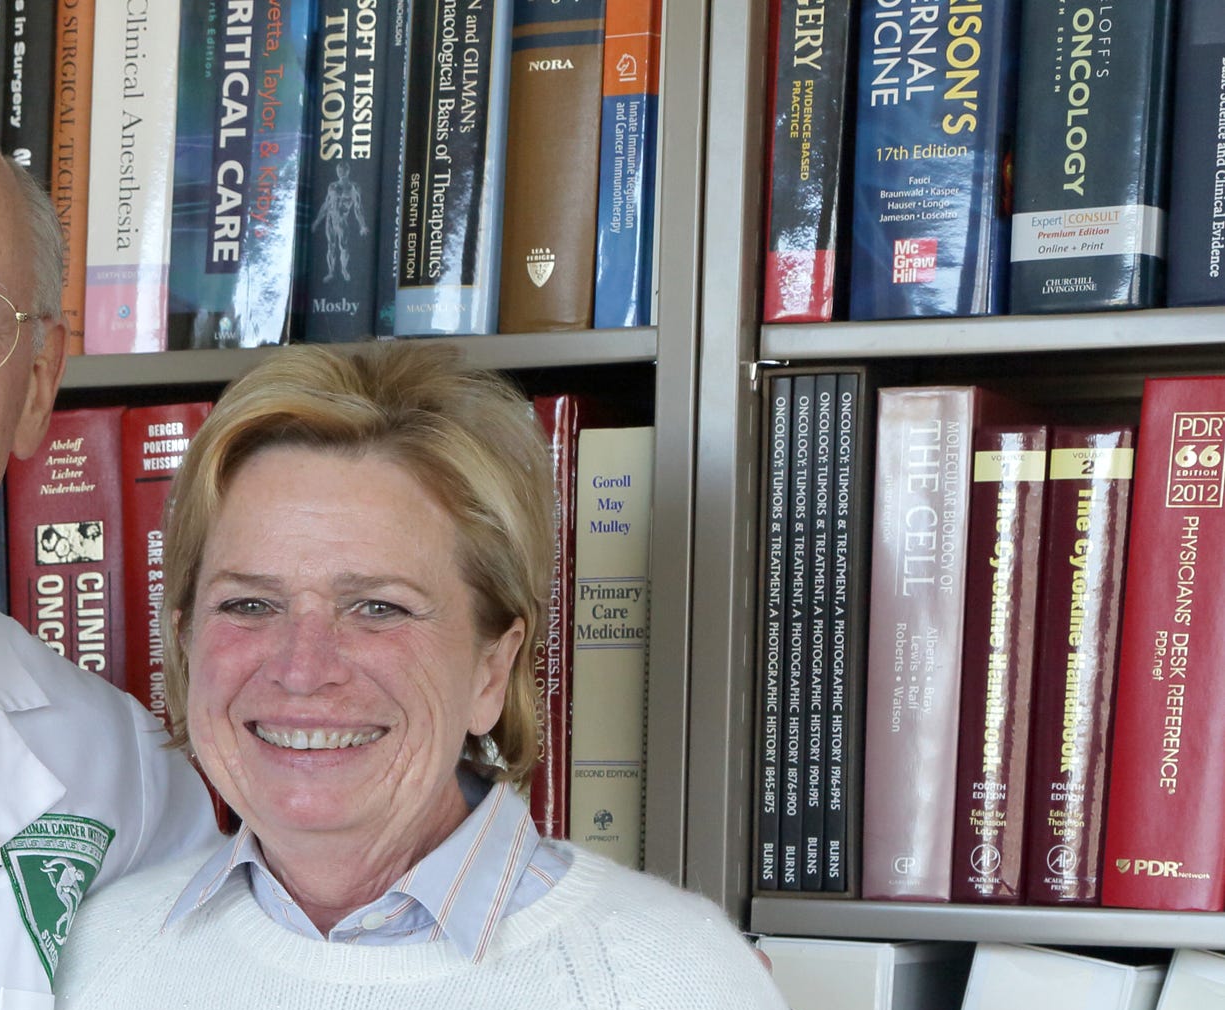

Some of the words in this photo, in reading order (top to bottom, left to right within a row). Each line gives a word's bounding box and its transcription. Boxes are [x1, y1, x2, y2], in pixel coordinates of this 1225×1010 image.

[14, 17, 26, 36] in
[353, 0, 376, 61] SOFT
[465, 15, 479, 43] and
[122, 0, 149, 99] Clinical
[528, 59, 574, 71] NORA
[10, 41, 26, 128] Surgery
[58, 16, 78, 133] SURGICAL
[320, 8, 349, 160] TUMORS
[460, 48, 479, 133] GILMAN's
[257, 64, 284, 134] Taylor,
[351, 68, 374, 159] TISSUE
[436, 98, 455, 140] Basis
[615, 102, 627, 119] and
[628, 101, 640, 133] Innate
[790, 80, 801, 138] PRACTICE
[1063, 8, 1095, 196] ONCOLOGY
[614, 122, 626, 154] Cancer
[800, 80, 814, 180] EVIDENCE-BASED
[435, 144, 451, 160] of
[626, 134, 639, 174] Immune
[876, 147, 909, 162] 17th
[913, 143, 968, 160] Edition
[116, 110, 143, 251] Anesthesia
[409, 173, 420, 227] SEVENTH
[610, 156, 624, 234] Immunotherapy
[880, 188, 924, 199] Braunwald
[929, 187, 960, 198] Kasper
[909, 175, 931, 185] Fauci
[212, 160, 245, 263] CARE
[428, 168, 451, 278] Therapeutics
[622, 176, 637, 228] Regulation
[879, 212, 915, 222] Jameson
[921, 210, 958, 221] Loscalzo
[887, 201, 917, 210] Hauser
[922, 199, 950, 210] Longo
[1031, 217, 1063, 228] Expert
[1068, 211, 1119, 224] CONSULT
[895, 240, 920, 254] Mc
[1037, 231, 1076, 240] Premium
[1078, 226, 1110, 236] Edition
[1038, 246, 1069, 255] Online
[1080, 241, 1104, 251] Print
[1210, 221, 1225, 278] Evidence
[406, 232, 417, 279] EDITION
[893, 268, 917, 283] Hill
[894, 254, 936, 269] Graw
[1042, 283, 1097, 294] LIVINGSTONE
[1045, 277, 1094, 287] CHURCHILL
[312, 297, 360, 315] Mosby
[49, 437, 84, 451] Abeloff
[143, 438, 190, 454] PORTENOY
[148, 422, 184, 437] BERGER
[774, 397, 786, 467] ONCOLOGY:
[797, 396, 809, 466] ONCOLOGY:
[818, 392, 830, 463] ONCOLOGY:
[839, 392, 851, 463] ONCOLOGY:
[1178, 417, 1223, 437] PDR
[45, 453, 88, 467] Armitage
[51, 467, 83, 480] Lichter
[906, 419, 941, 494] THE
[942, 421, 960, 506] MOLECULAR
[1081, 460, 1095, 475] 2
[1175, 444, 1221, 468] 66
[40, 482, 96, 495] Niederhuber
[592, 475, 631, 488] Goroll
[772, 470, 784, 519] TUMORS
[795, 469, 807, 519] TUMORS
[816, 466, 828, 516] TUMORS
[838, 466, 849, 516] TUMORS
[1171, 484, 1219, 502] 2012
[597, 498, 625, 514] May
[771, 522, 781, 532] &
[794, 522, 804, 532] &
[816, 519, 825, 529] &
[837, 519, 846, 530] &
[1076, 489, 1094, 532] The
[147, 530, 164, 565] CARE
[589, 520, 631, 535] Mulley
[940, 511, 957, 573] BIOLOGY
[769, 536, 782, 606] TREATMENT,
[792, 536, 805, 606] TREATMENT,
[813, 532, 826, 604] TREATMENT,
[835, 532, 847, 604] TREATMENT,
[902, 506, 940, 597] CELL
[1174, 516, 1200, 626] PHYSICIANS'
[579, 584, 643, 602] Primary
[939, 577, 954, 595] OF
[989, 540, 1014, 648] Cytokine
[1069, 539, 1092, 648] Cytokine
[591, 604, 628, 620] Care
[769, 609, 778, 618] A
[792, 608, 801, 618] A
[814, 605, 823, 615] A
[835, 605, 845, 616] A
[576, 623, 644, 641] Medicine
[894, 621, 907, 672] Roberts
[925, 626, 938, 672] Alberts
[766, 622, 779, 712] PHOTOGRAPHIC
[789, 622, 801, 712] PHOTOGRAPHIC
[811, 620, 823, 711] PHOTOGRAPHIC
[832, 620, 845, 711] PHOTOGRAPHIC
[909, 635, 922, 672] Lewis
[1152, 630, 1168, 681] PDR.net
[1170, 633, 1190, 678] DESK
[890, 686, 904, 733] Watson
[907, 685, 920, 710] Raff
[921, 687, 935, 715] Bray
[982, 653, 1008, 773] Handbook
[1060, 653, 1085, 774] Handbook
[765, 716, 776, 762] HISTORY
[787, 716, 799, 763] HISTORY
[809, 714, 821, 761] HISTORY
[831, 714, 843, 762] HISTORY
[575, 770, 604, 778] SECOND
[605, 769, 639, 779] EDITION
[763, 766, 774, 813] 1845-1875
[786, 767, 797, 815] 1876-1900
[808, 765, 819, 807] 1901-1915
[830, 766, 841, 810] 1916-1945
[51, 824, 85, 839] CANCER
[584, 834, 620, 842] LIPPINCOTT
[763, 843, 773, 880] BURNS
[784, 845, 795, 882] BURNS
[807, 837, 818, 874] BURNS
[829, 840, 840, 878] BURNS
